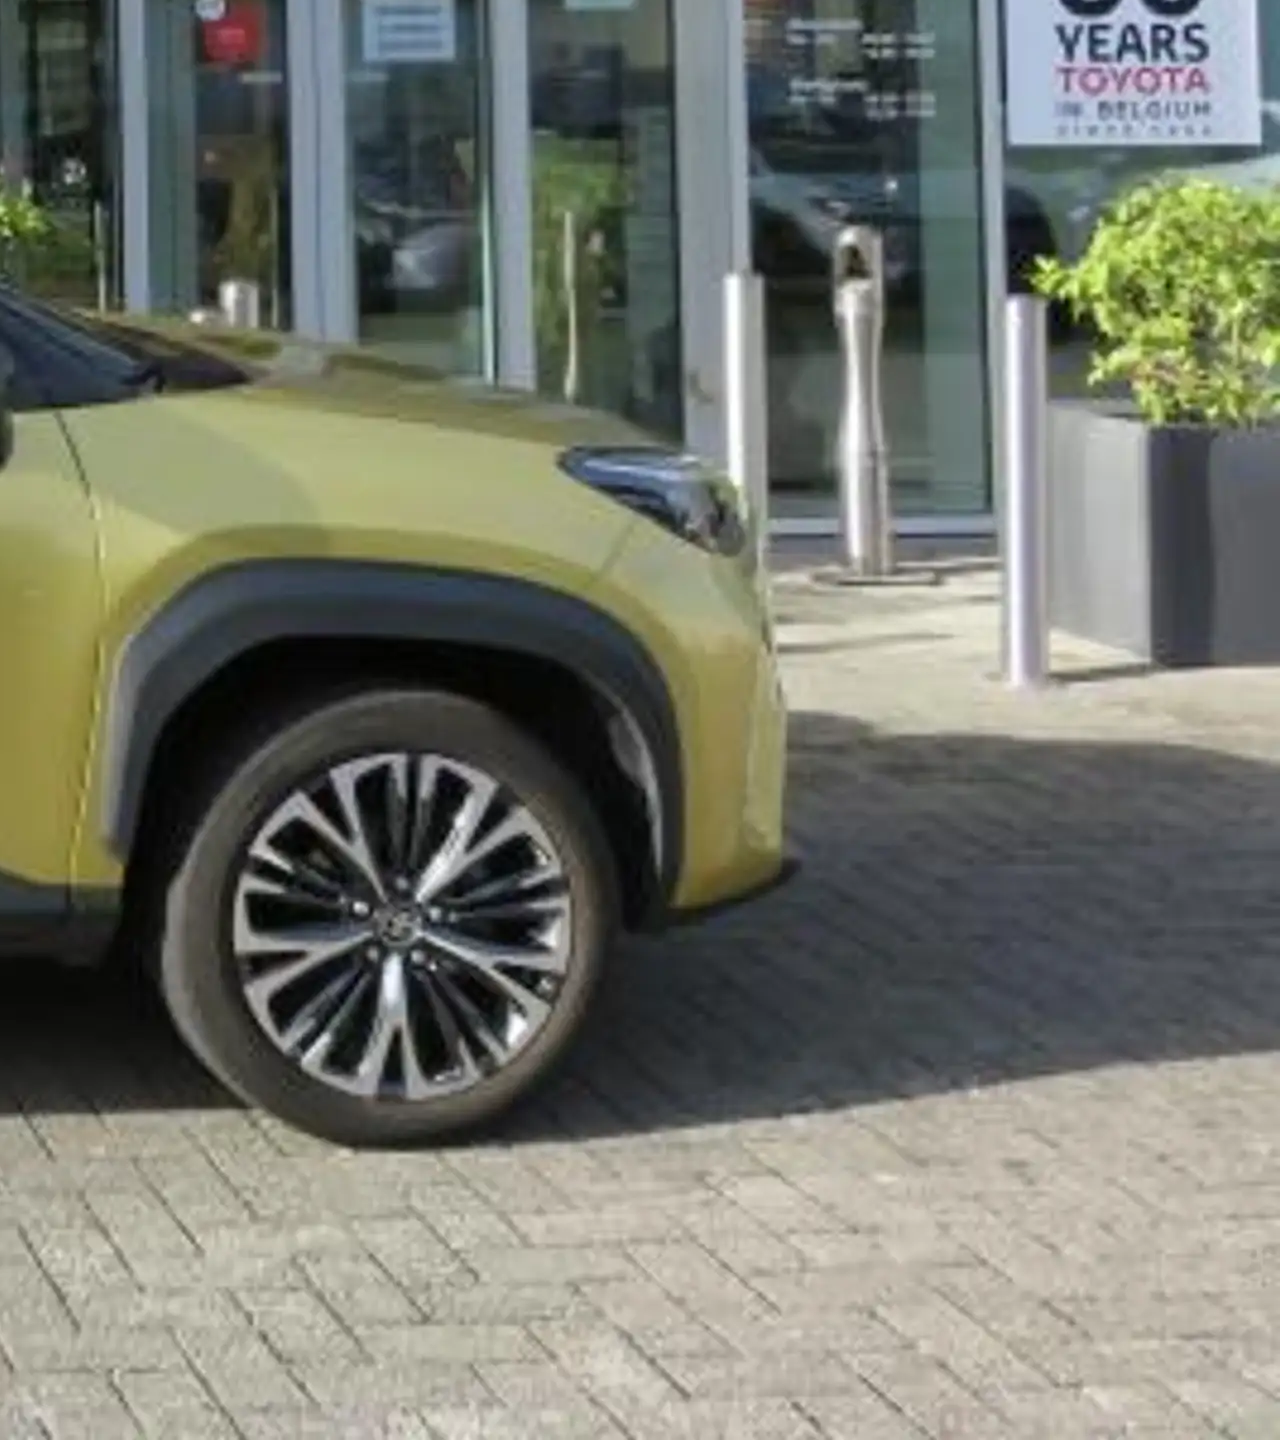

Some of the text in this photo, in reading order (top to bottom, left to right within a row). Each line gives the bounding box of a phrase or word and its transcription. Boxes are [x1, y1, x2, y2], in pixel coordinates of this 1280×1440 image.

[1055, 23, 1210, 62] YEARS
[1055, 66, 1209, 96] TOYOTA
[1097, 100, 1212, 121] BELGIUM
